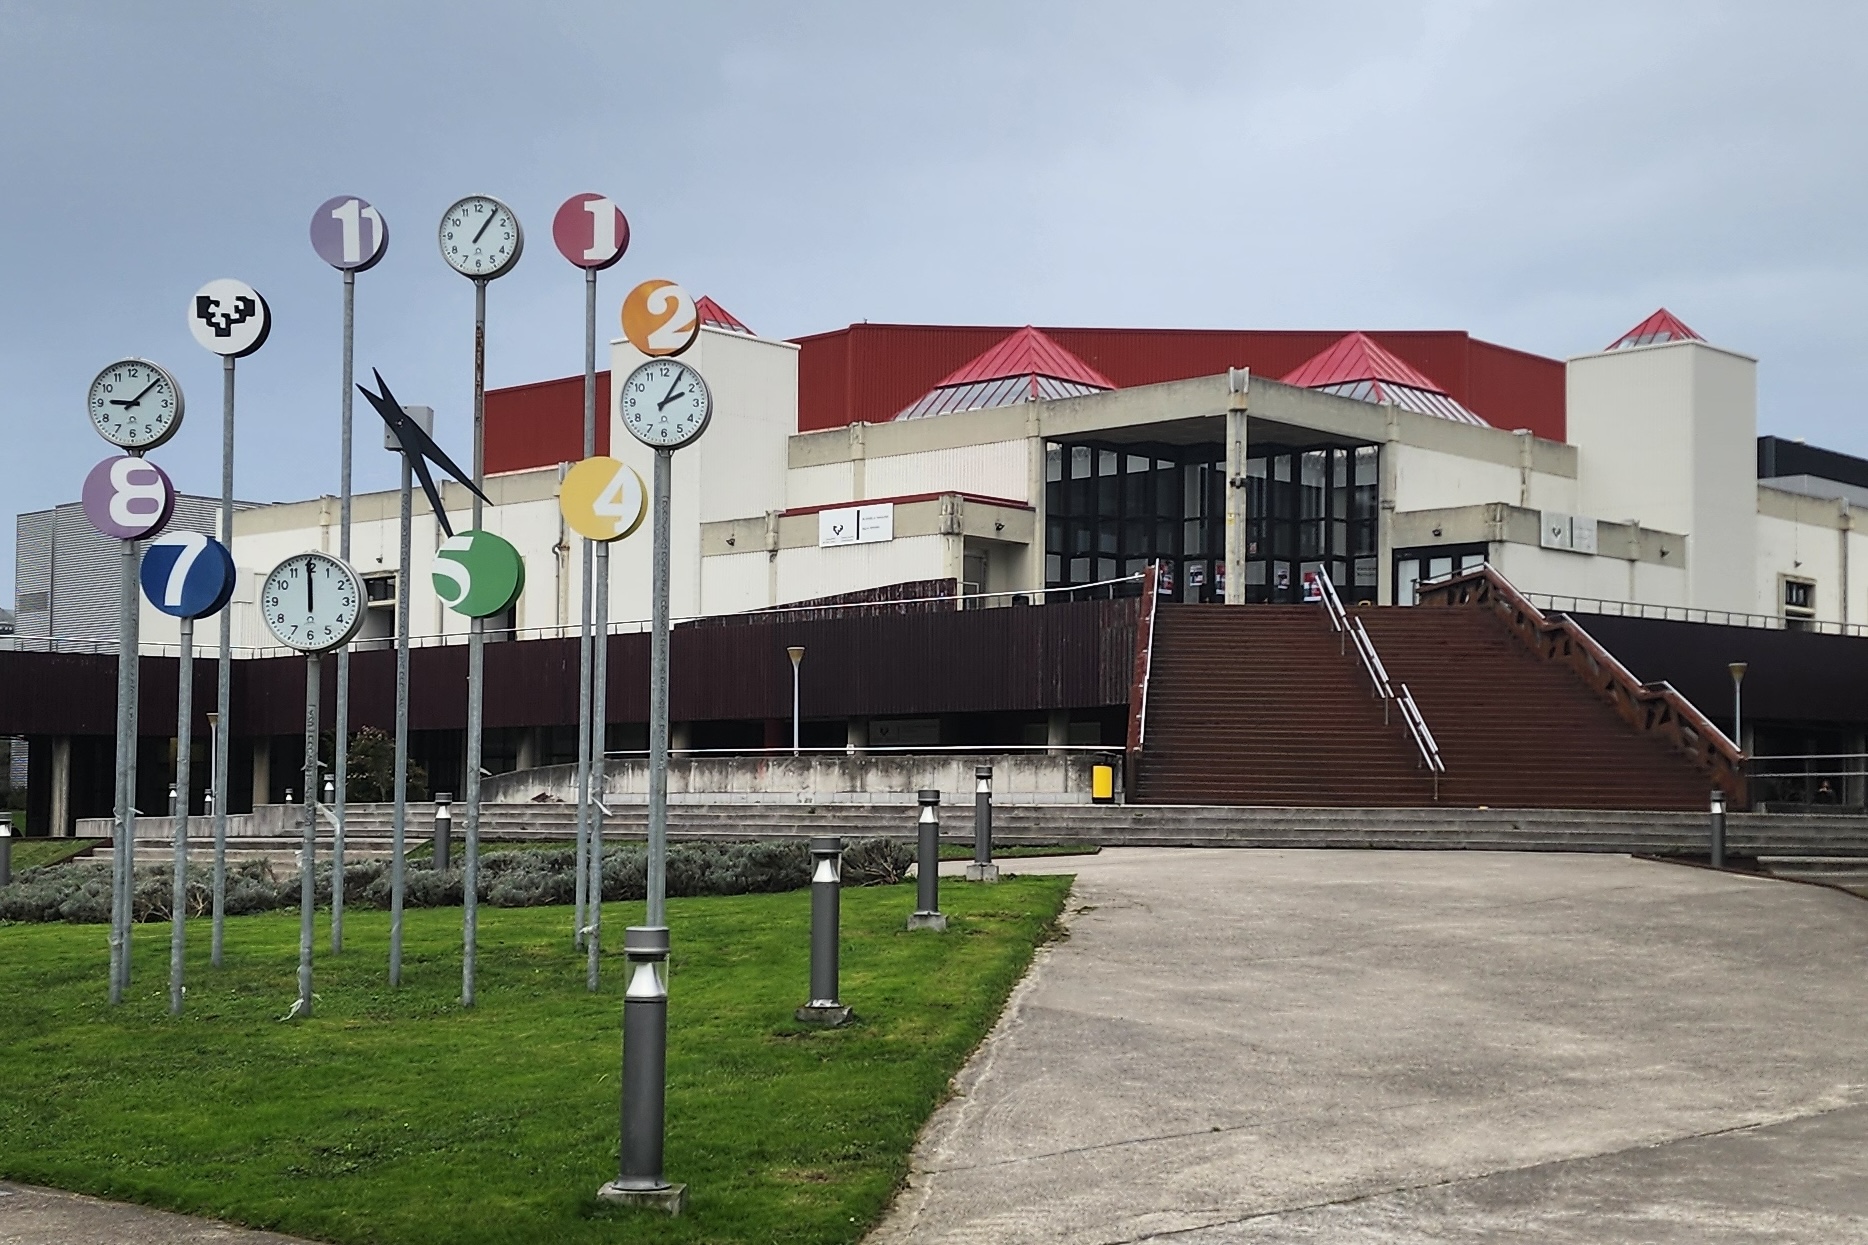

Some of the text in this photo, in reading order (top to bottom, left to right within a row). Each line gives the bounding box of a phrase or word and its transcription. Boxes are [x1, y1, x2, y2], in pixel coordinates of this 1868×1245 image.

[462, 208, 469, 217] 11
[474, 204, 483, 213] 12
[451, 218, 461, 227] 10
[499, 218, 506, 227] 2
[332, 199, 383, 262] 11
[584, 198, 619, 260] 1
[447, 232, 453, 240] 9
[503, 231, 510, 240] 3
[451, 245, 458, 254] 8
[499, 245, 505, 254] 4
[462, 255, 469, 263] 7
[475, 259, 481, 268] 6
[489, 255, 496, 263] 5
[647, 285, 697, 350] 2
[127, 368, 138, 378] 12
[646, 372, 653, 381] 11
[660, 367, 670, 377] 12
[113, 373, 122, 382] 11
[147, 373, 150, 382] 1
[102, 384, 113, 393] 10
[157, 384, 164, 393] 2
[635, 383, 645, 392] 10
[688, 383, 695, 393] 2
[97, 398, 104, 407] 9
[161, 399, 168, 408] 3
[629, 398, 636, 407] 9
[692, 398, 699, 407] 3
[102, 413, 109, 423] 8
[155, 413, 162, 423] 4
[634, 413, 641, 422] 8
[687, 413, 693, 422] 4
[114, 424, 121, 433] 7
[145, 424, 152, 434] 5
[646, 424, 653, 433] 7
[661, 428, 667, 437] 6
[676, 424, 683, 433] 5
[129, 429, 136, 438] 6
[109, 457, 165, 527] 8
[592, 464, 642, 534] 4
[151, 530, 208, 606] 7
[289, 567, 298, 578] 11
[432, 535, 474, 608] 5
[326, 568, 330, 578] 1
[277, 580, 289, 590] 10
[337, 580, 344, 590] 2
[271, 596, 278, 607] 9
[342, 596, 350, 607] 3
[277, 613, 284, 623] 8
[336, 613, 343, 623] 4
[290, 625, 298, 635] 7
[324, 625, 331, 635] 5
[307, 630, 314, 640] 6
